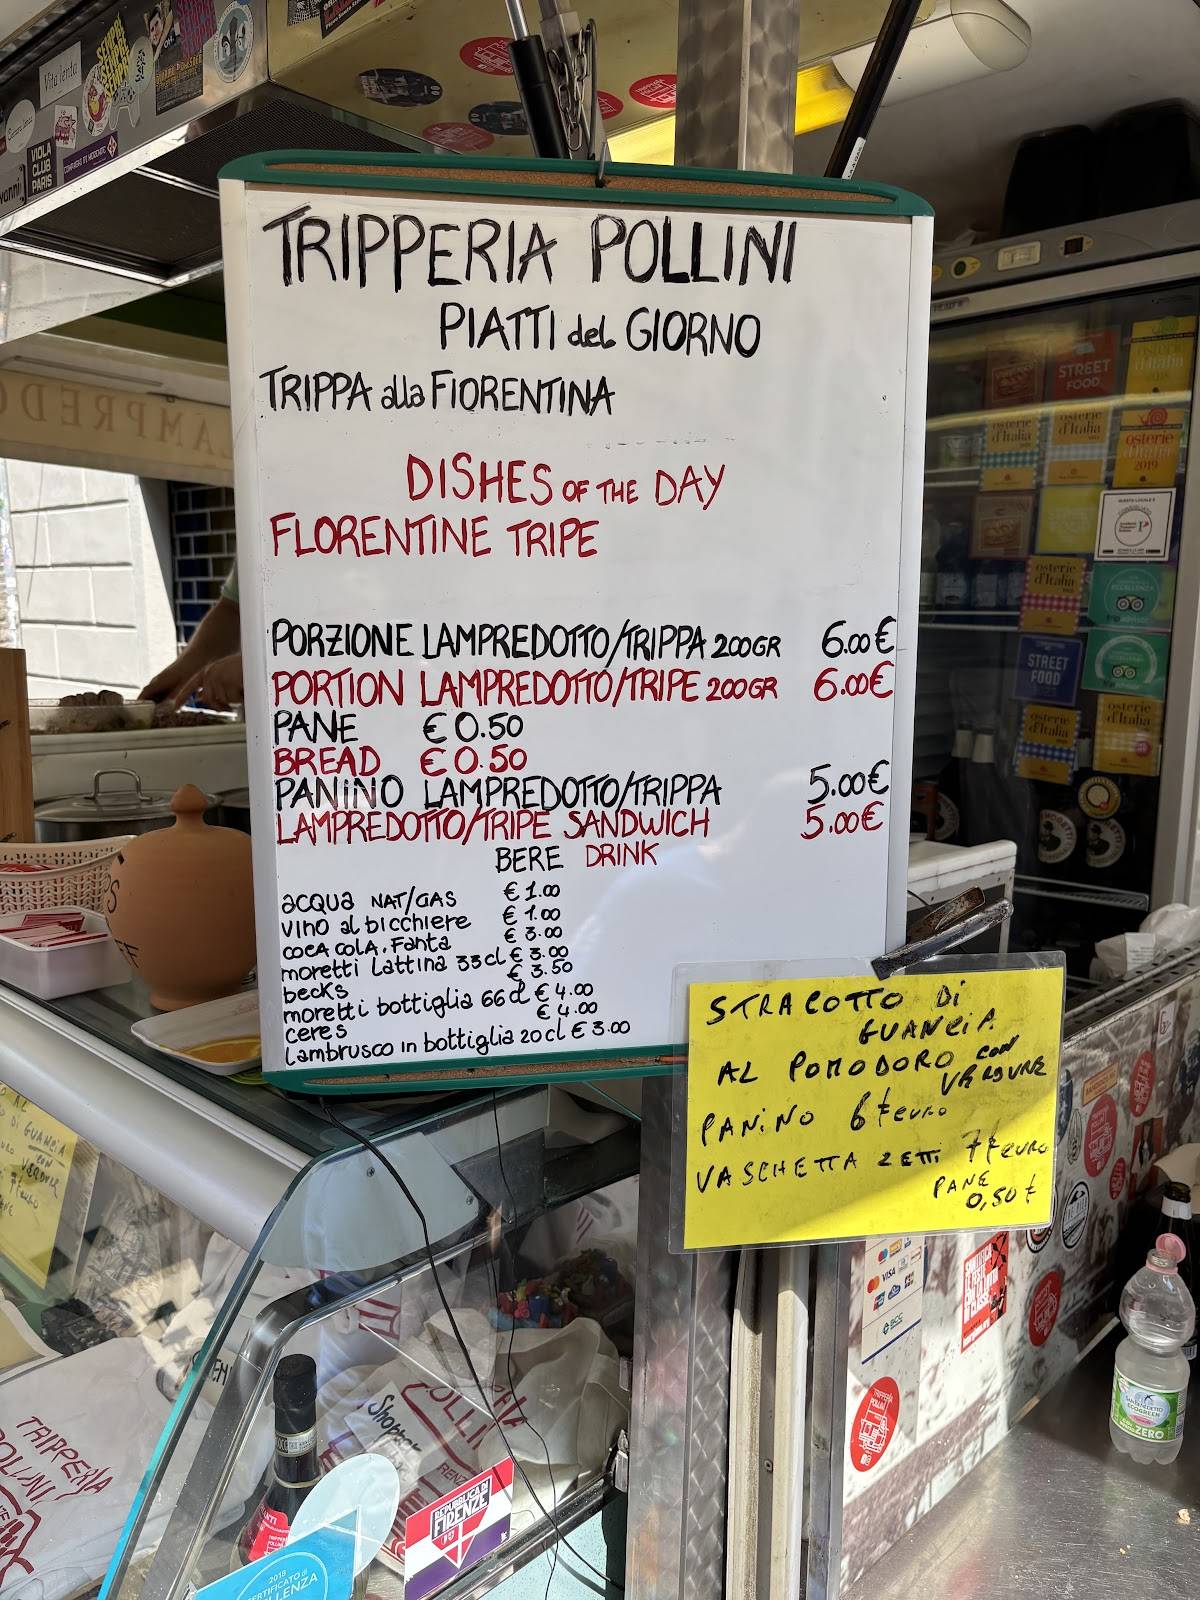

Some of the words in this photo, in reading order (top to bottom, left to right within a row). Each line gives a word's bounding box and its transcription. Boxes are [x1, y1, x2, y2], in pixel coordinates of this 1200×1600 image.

[44, 70, 58, 90] Vita
[31, 143, 51, 158] VIOLA
[32, 158, 51, 177] CLUB
[32, 174, 52, 193] PARIS
[262, 203, 557, 293] TRIPPERIA
[591, 213, 797, 286] POLLINI
[440, 302, 555, 350] PIATTI
[568, 314, 616, 349] del
[626, 306, 760, 358] GIORNO
[1058, 359, 1111, 379] STREET
[259, 365, 372, 412] TRIPPA
[381, 374, 425, 410] alla
[432, 370, 615, 416] FIORENTINA
[1066, 377, 1100, 391] FOOD
[1126, 432, 1174, 447] osterie
[1134, 460, 1158, 471] 2019
[406, 452, 553, 506] DISHES
[562, 480, 590, 502] OF
[596, 478, 639, 505] THE
[654, 464, 726, 511] DAY
[270, 512, 492, 558] FLORENTINE
[507, 519, 599, 558] TRIPE
[1034, 571, 1075, 587] d'Italia
[1036, 562, 1076, 573] osterie
[272, 618, 414, 657] PORZIONE
[422, 618, 706, 668] LAMPREDOTTO/TRIPPA
[821, 615, 896, 658] 6.00€
[1027, 654, 1069, 671] STREET
[272, 668, 403, 708] PORTION
[420, 667, 701, 708] LAMPREDOTTO/TRIPE
[813, 660, 895, 702] 6.00€
[1031, 669, 1061, 687] FOOD
[1029, 712, 1069, 725] osterie
[1108, 702, 1151, 713] osterie
[274, 709, 359, 745] PANE
[273, 746, 381, 777] BREAD
[424, 771, 722, 814] LAMPREDOTTO/TRIPPA
[807, 759, 890, 805] 5.00€
[276, 808, 552, 846] LAMPREDOTTO/TRIPE
[563, 806, 710, 840] SANDWICH
[800, 800, 884, 840] 5.00€
[495, 846, 563, 873] BERE
[586, 840, 659, 868] DRINK
[371, 886, 457, 915] NAT/GAS
[282, 918, 329, 938] vino
[340, 915, 360, 934] al
[365, 913, 472, 934] bicchiere
[281, 959, 359, 982] moretti
[283, 1000, 369, 1024] moretti
[377, 987, 473, 1018] bottiglia
[285, 1024, 348, 1044] ceres
[401, 1041, 417, 1053] in
[424, 1024, 514, 1055] bottiglia
[717, 1062, 758, 1086] AL
[789, 1049, 955, 1082] POMODORO
[697, 1151, 858, 1194] VASCHETTA
[933, 1170, 990, 1198] PANE
[882, 1267, 896, 1282] VISA
[1135, 1426, 1164, 1440] ZERO
[16, 1416, 113, 1495] TRIPPERIA
[434, 1487, 480, 1519] REPUBBLICA
[434, 1490, 489, 1538] FIRENZE
[266, 1572, 318, 1600] LLENZA
[269, 1569, 287, 1583] 2018
